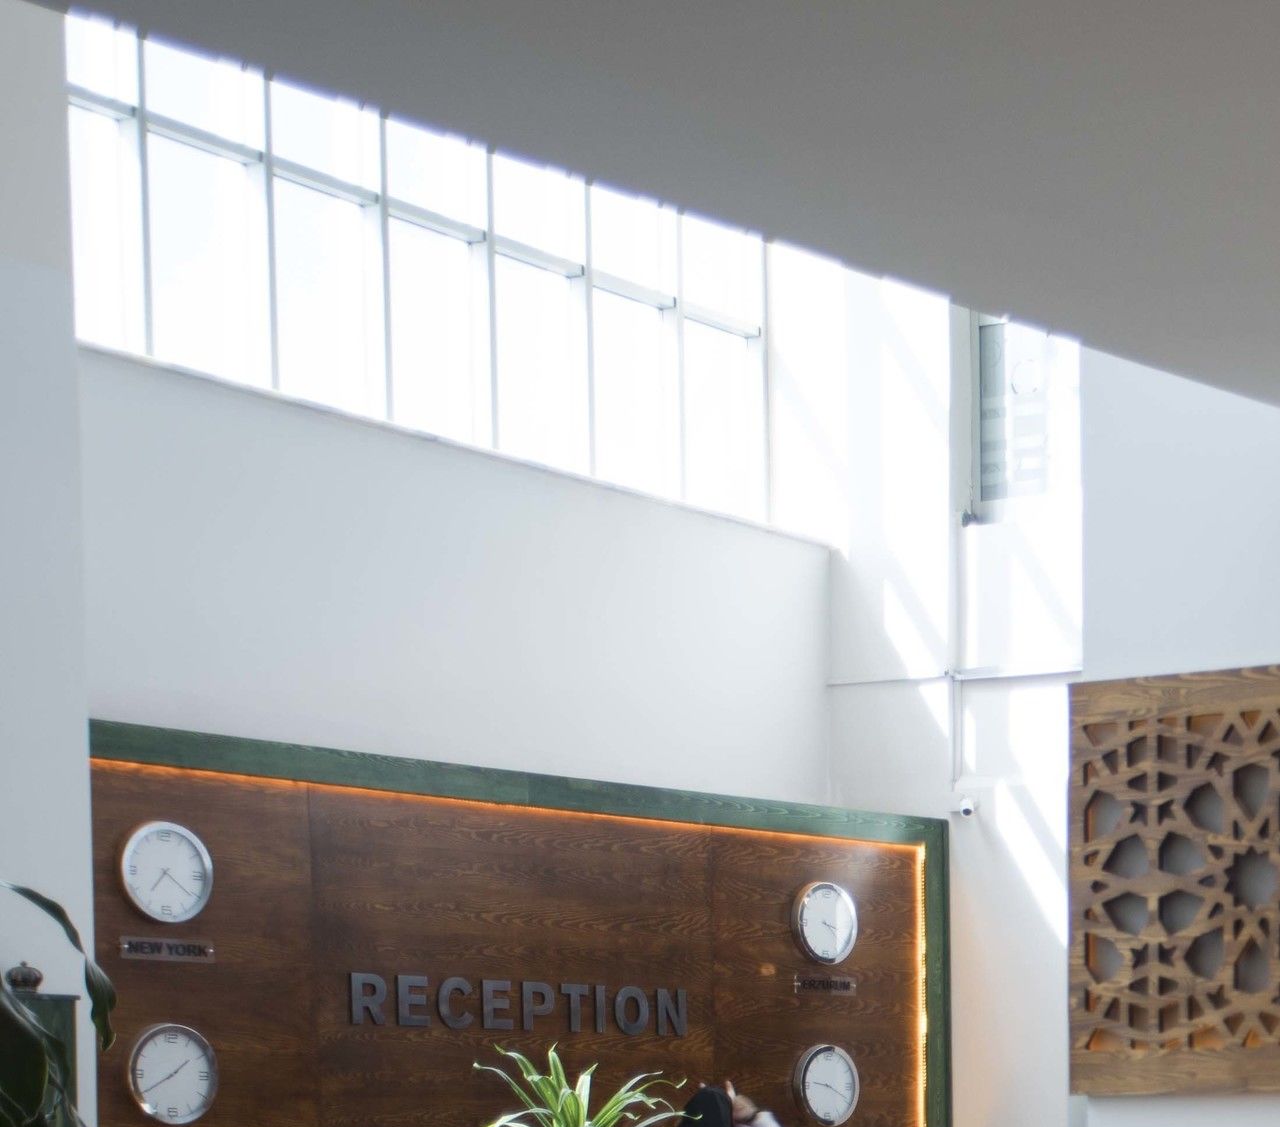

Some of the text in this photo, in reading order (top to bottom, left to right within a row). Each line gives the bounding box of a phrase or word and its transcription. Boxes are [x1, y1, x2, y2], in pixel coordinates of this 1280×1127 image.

[127, 941, 207, 957] NEW YORK
[349, 972, 687, 1036] RECEPTION
